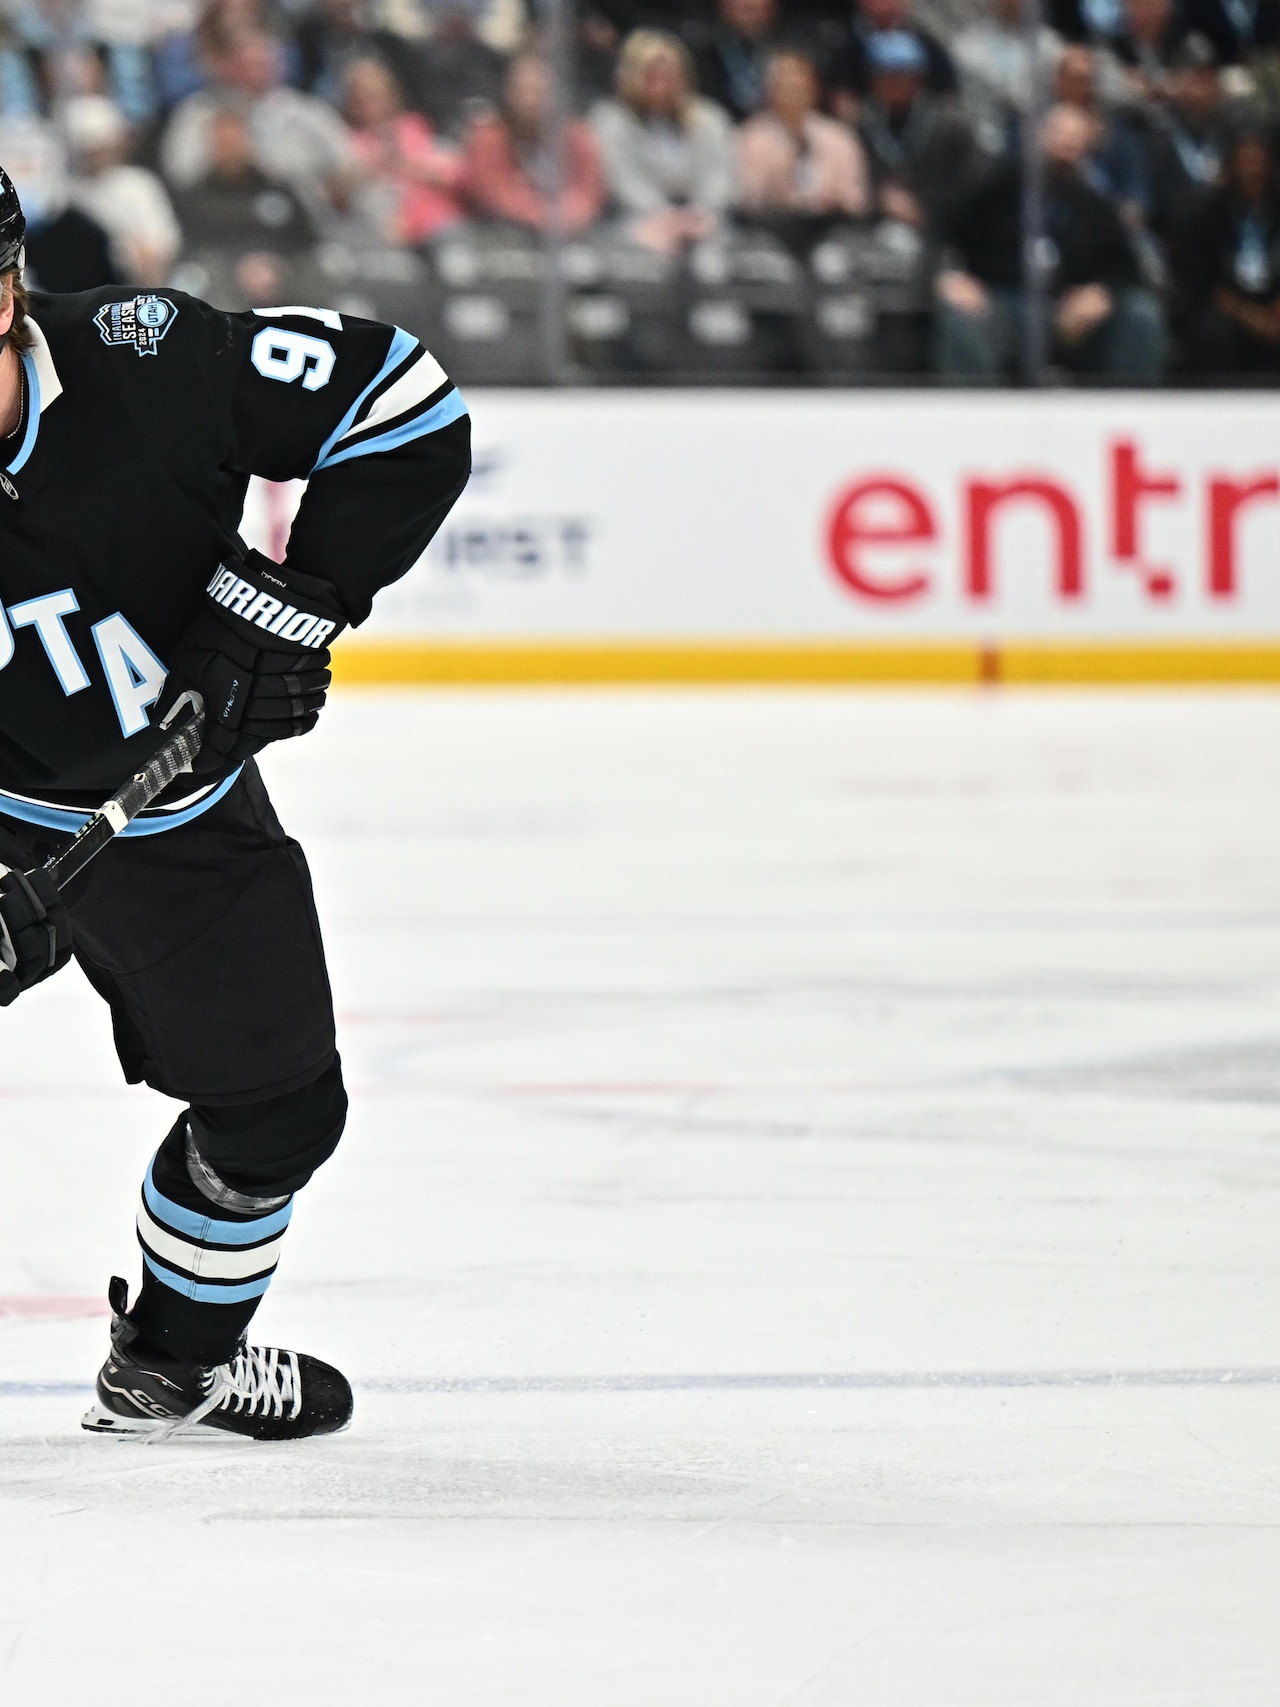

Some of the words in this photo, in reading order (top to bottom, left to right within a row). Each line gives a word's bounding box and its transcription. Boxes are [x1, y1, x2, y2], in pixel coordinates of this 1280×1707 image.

[147, 304, 159, 324] UTAH
[428, 515, 596, 578] IRST
[822, 435, 1280, 602] entr
